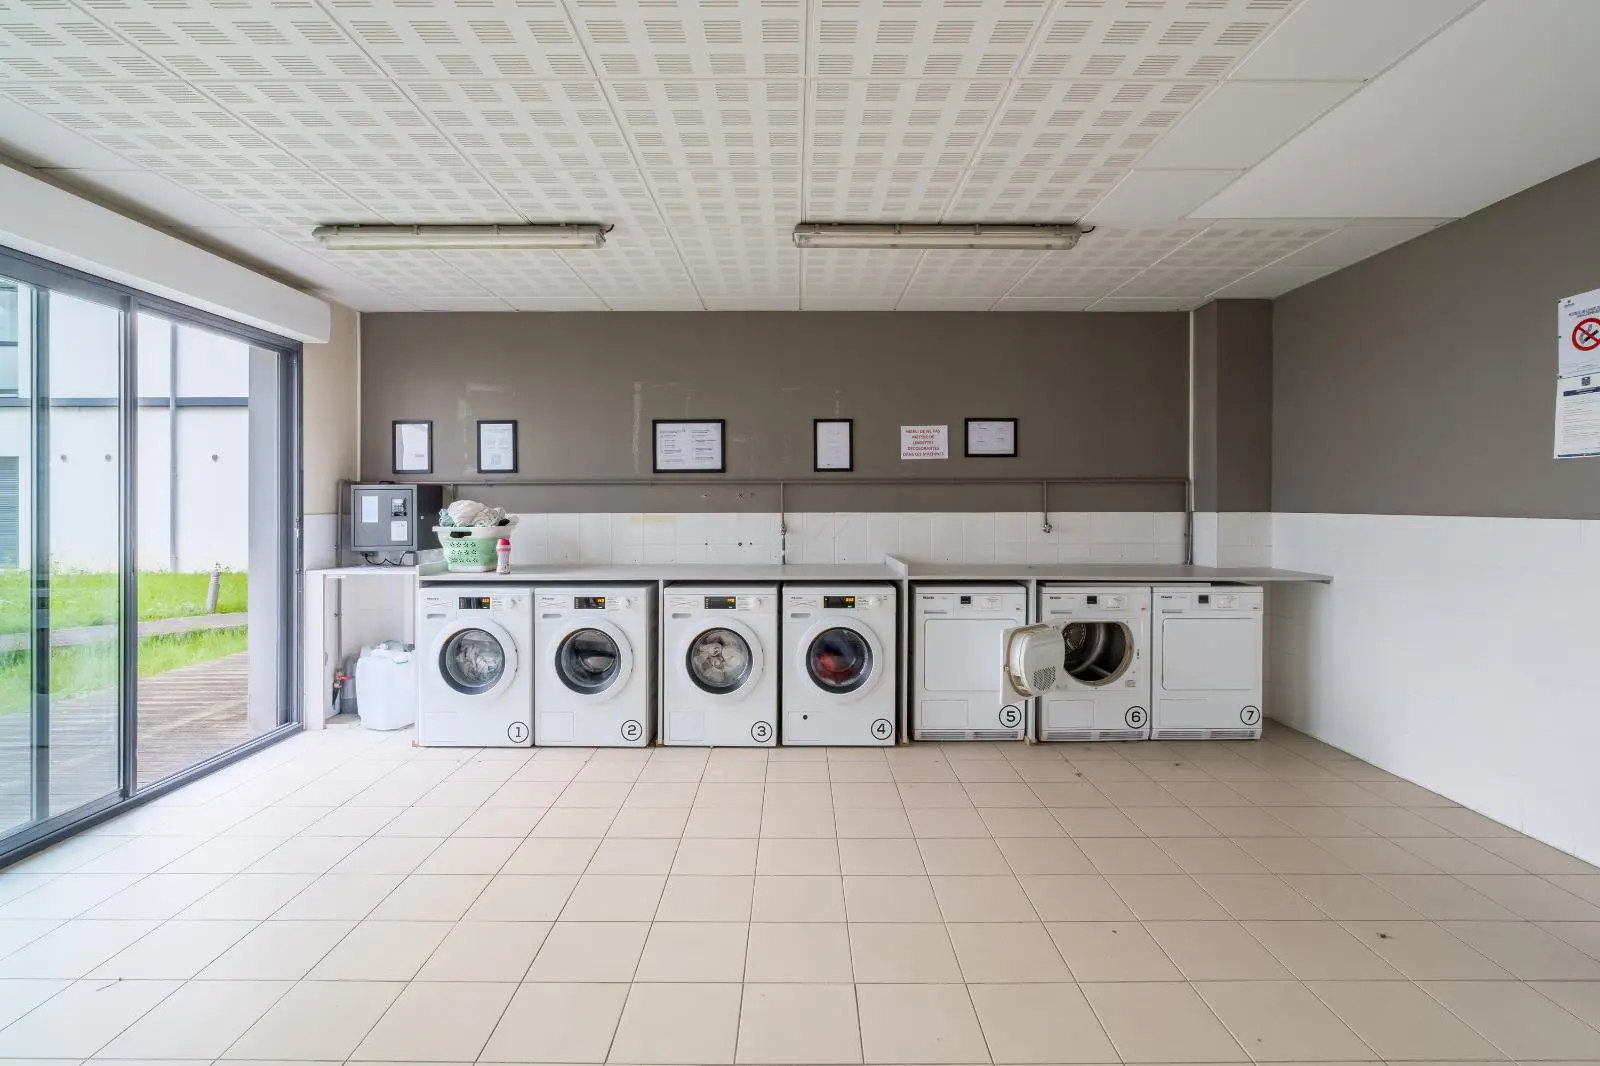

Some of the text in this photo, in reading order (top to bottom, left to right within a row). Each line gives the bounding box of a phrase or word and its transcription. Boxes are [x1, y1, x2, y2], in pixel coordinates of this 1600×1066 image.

[1006, 711, 1015, 722] 5
[1132, 711, 1141, 722] 6
[1246, 710, 1255, 721] 7
[515, 726, 522, 738] 1
[627, 725, 637, 736] 2
[757, 726, 766, 737] 3
[876, 723, 886, 735] 4
